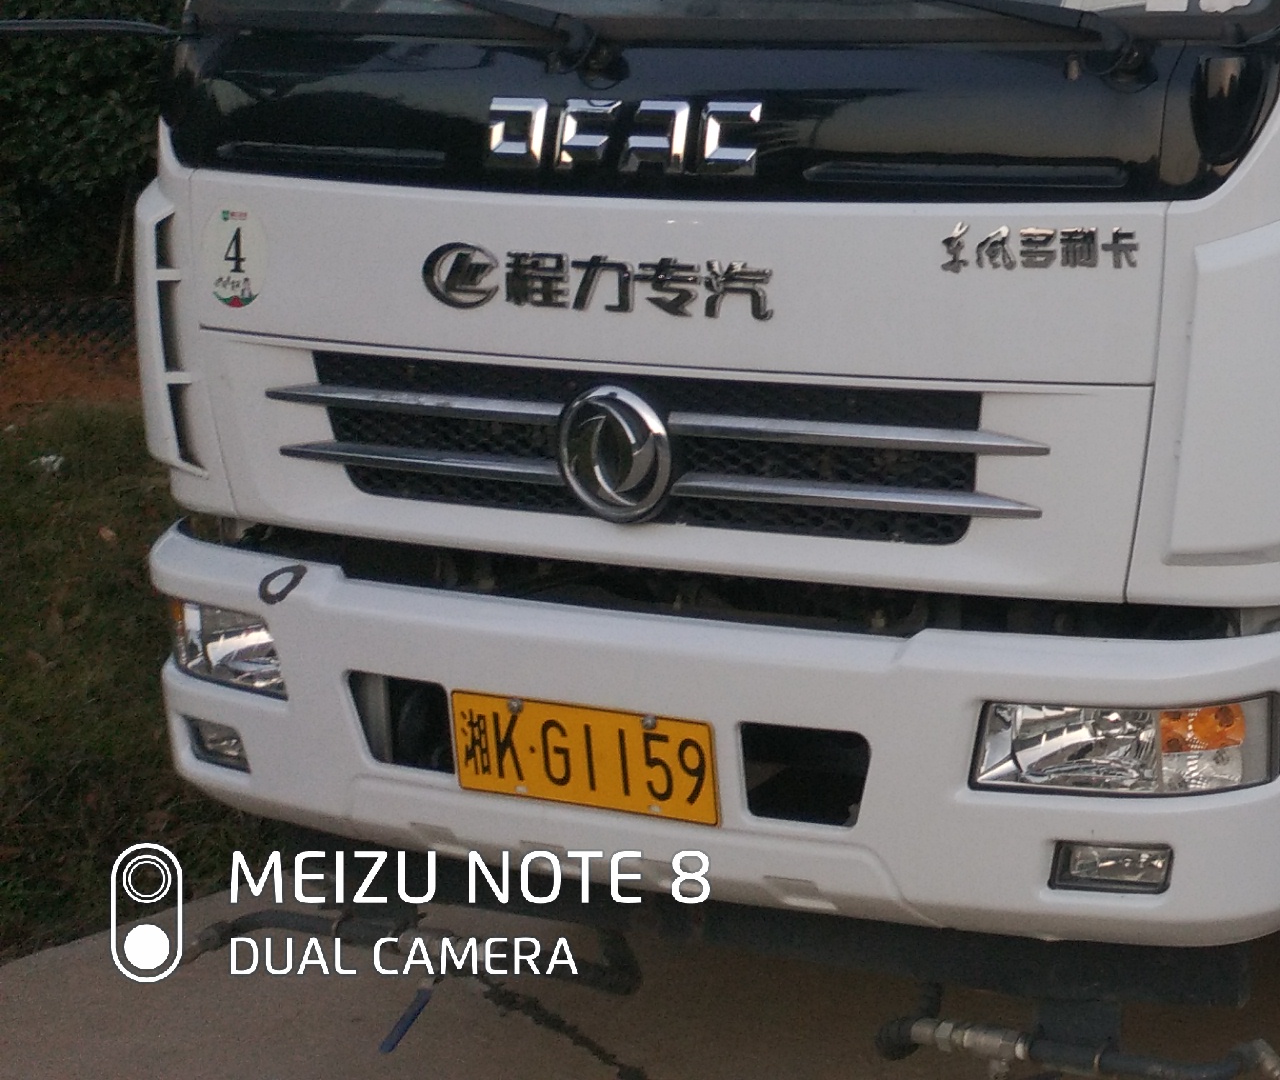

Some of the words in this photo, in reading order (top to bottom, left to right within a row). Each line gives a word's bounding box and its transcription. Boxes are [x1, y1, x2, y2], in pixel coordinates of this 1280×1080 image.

[488, 96, 763, 176] DFAC
[224, 226, 246, 273] 4
[505, 250, 774, 321] 程力专汽
